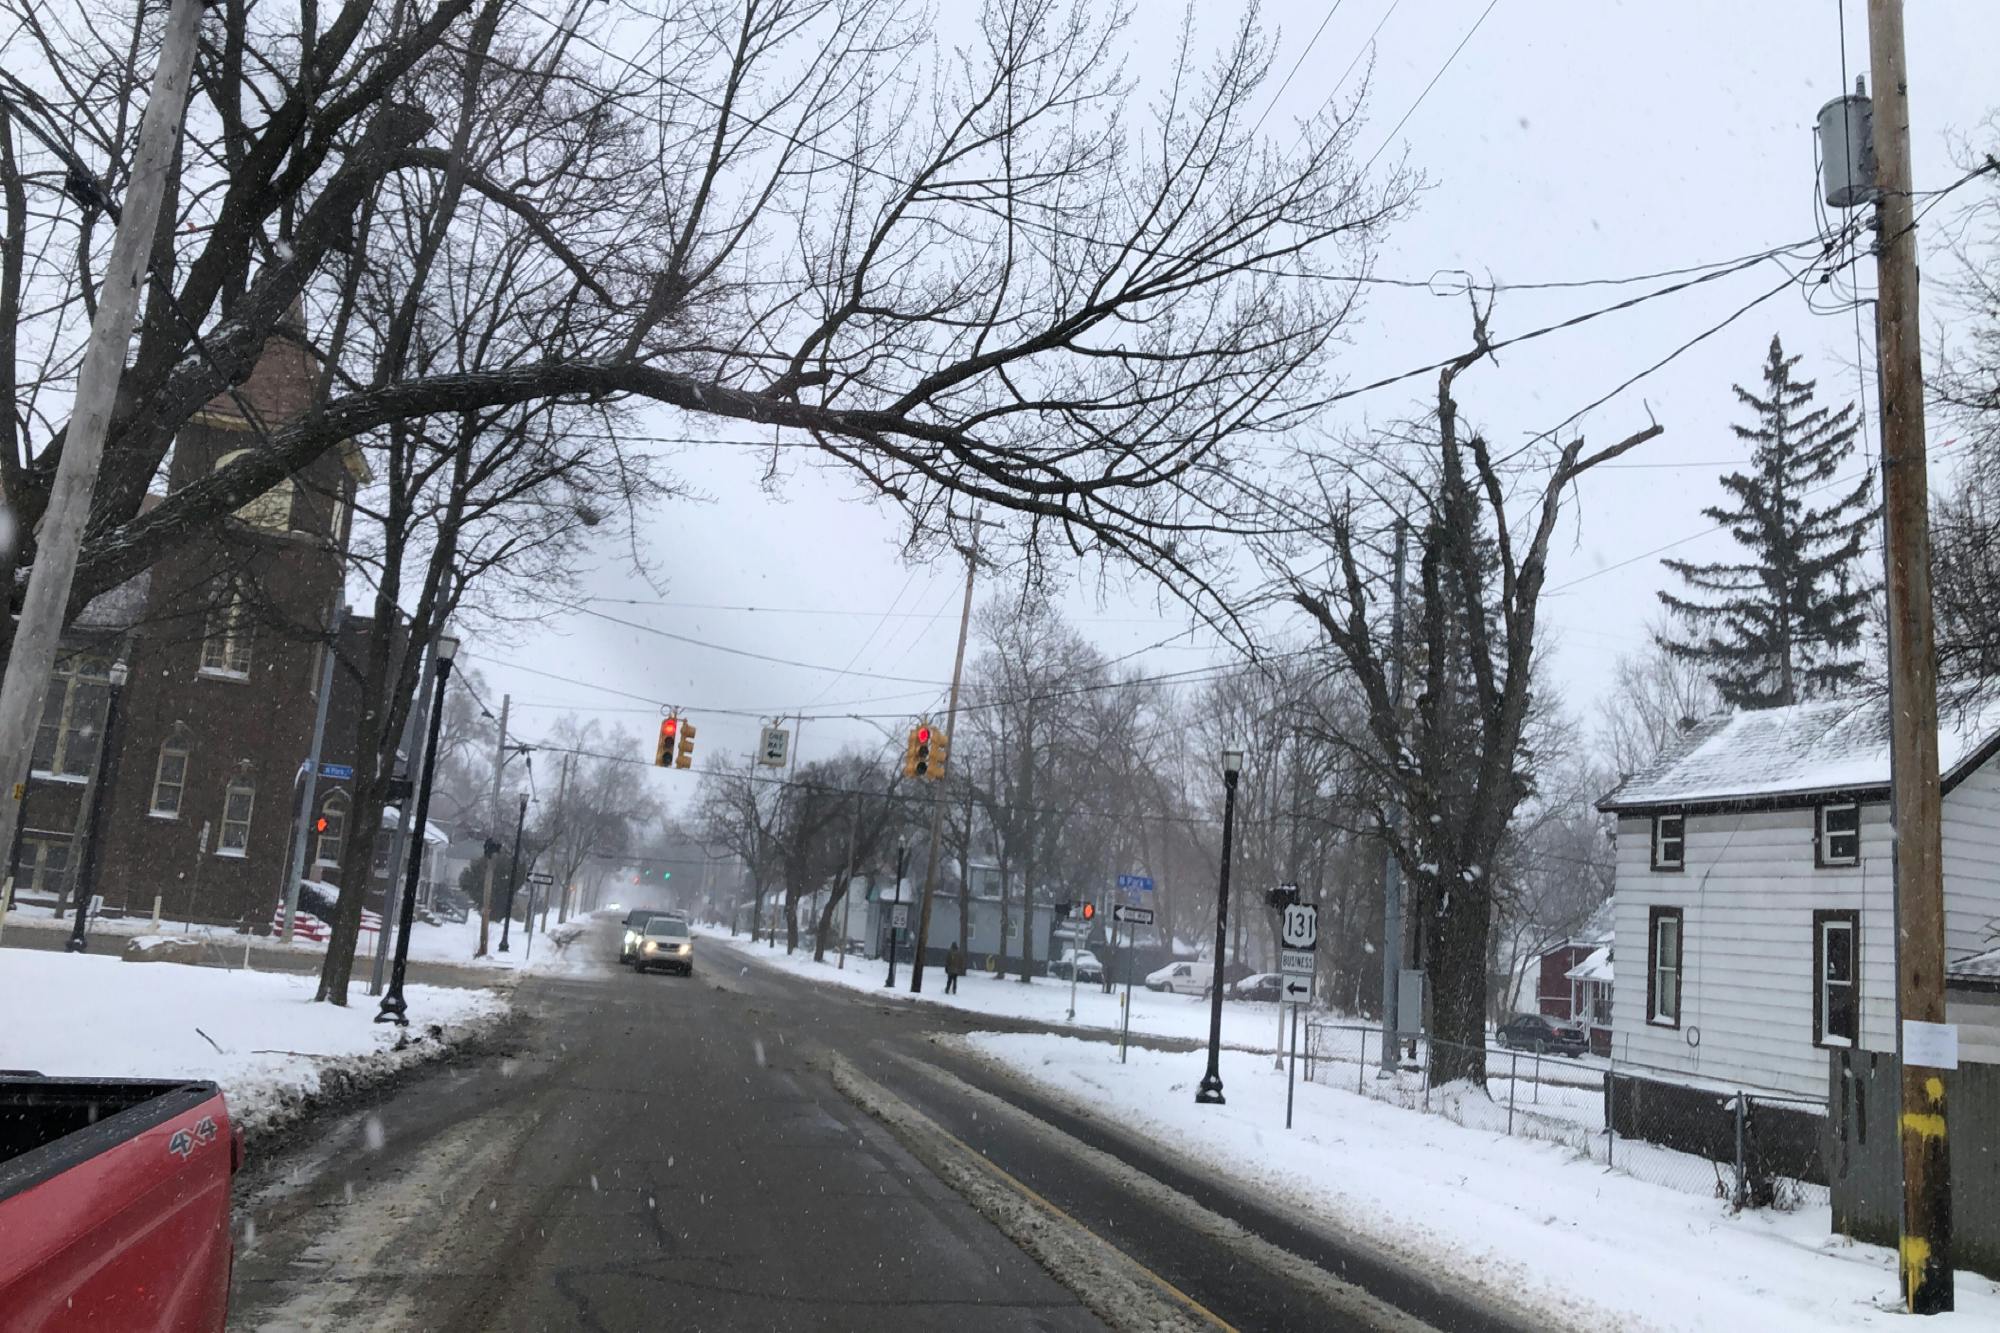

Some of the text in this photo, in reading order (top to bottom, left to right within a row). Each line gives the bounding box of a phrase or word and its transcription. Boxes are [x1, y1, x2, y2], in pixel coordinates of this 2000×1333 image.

[769, 732, 783, 741] ONE
[768, 742, 783, 750] WAY
[1288, 911, 1313, 938] 131
[1282, 955, 1313, 969] BUSINESS
